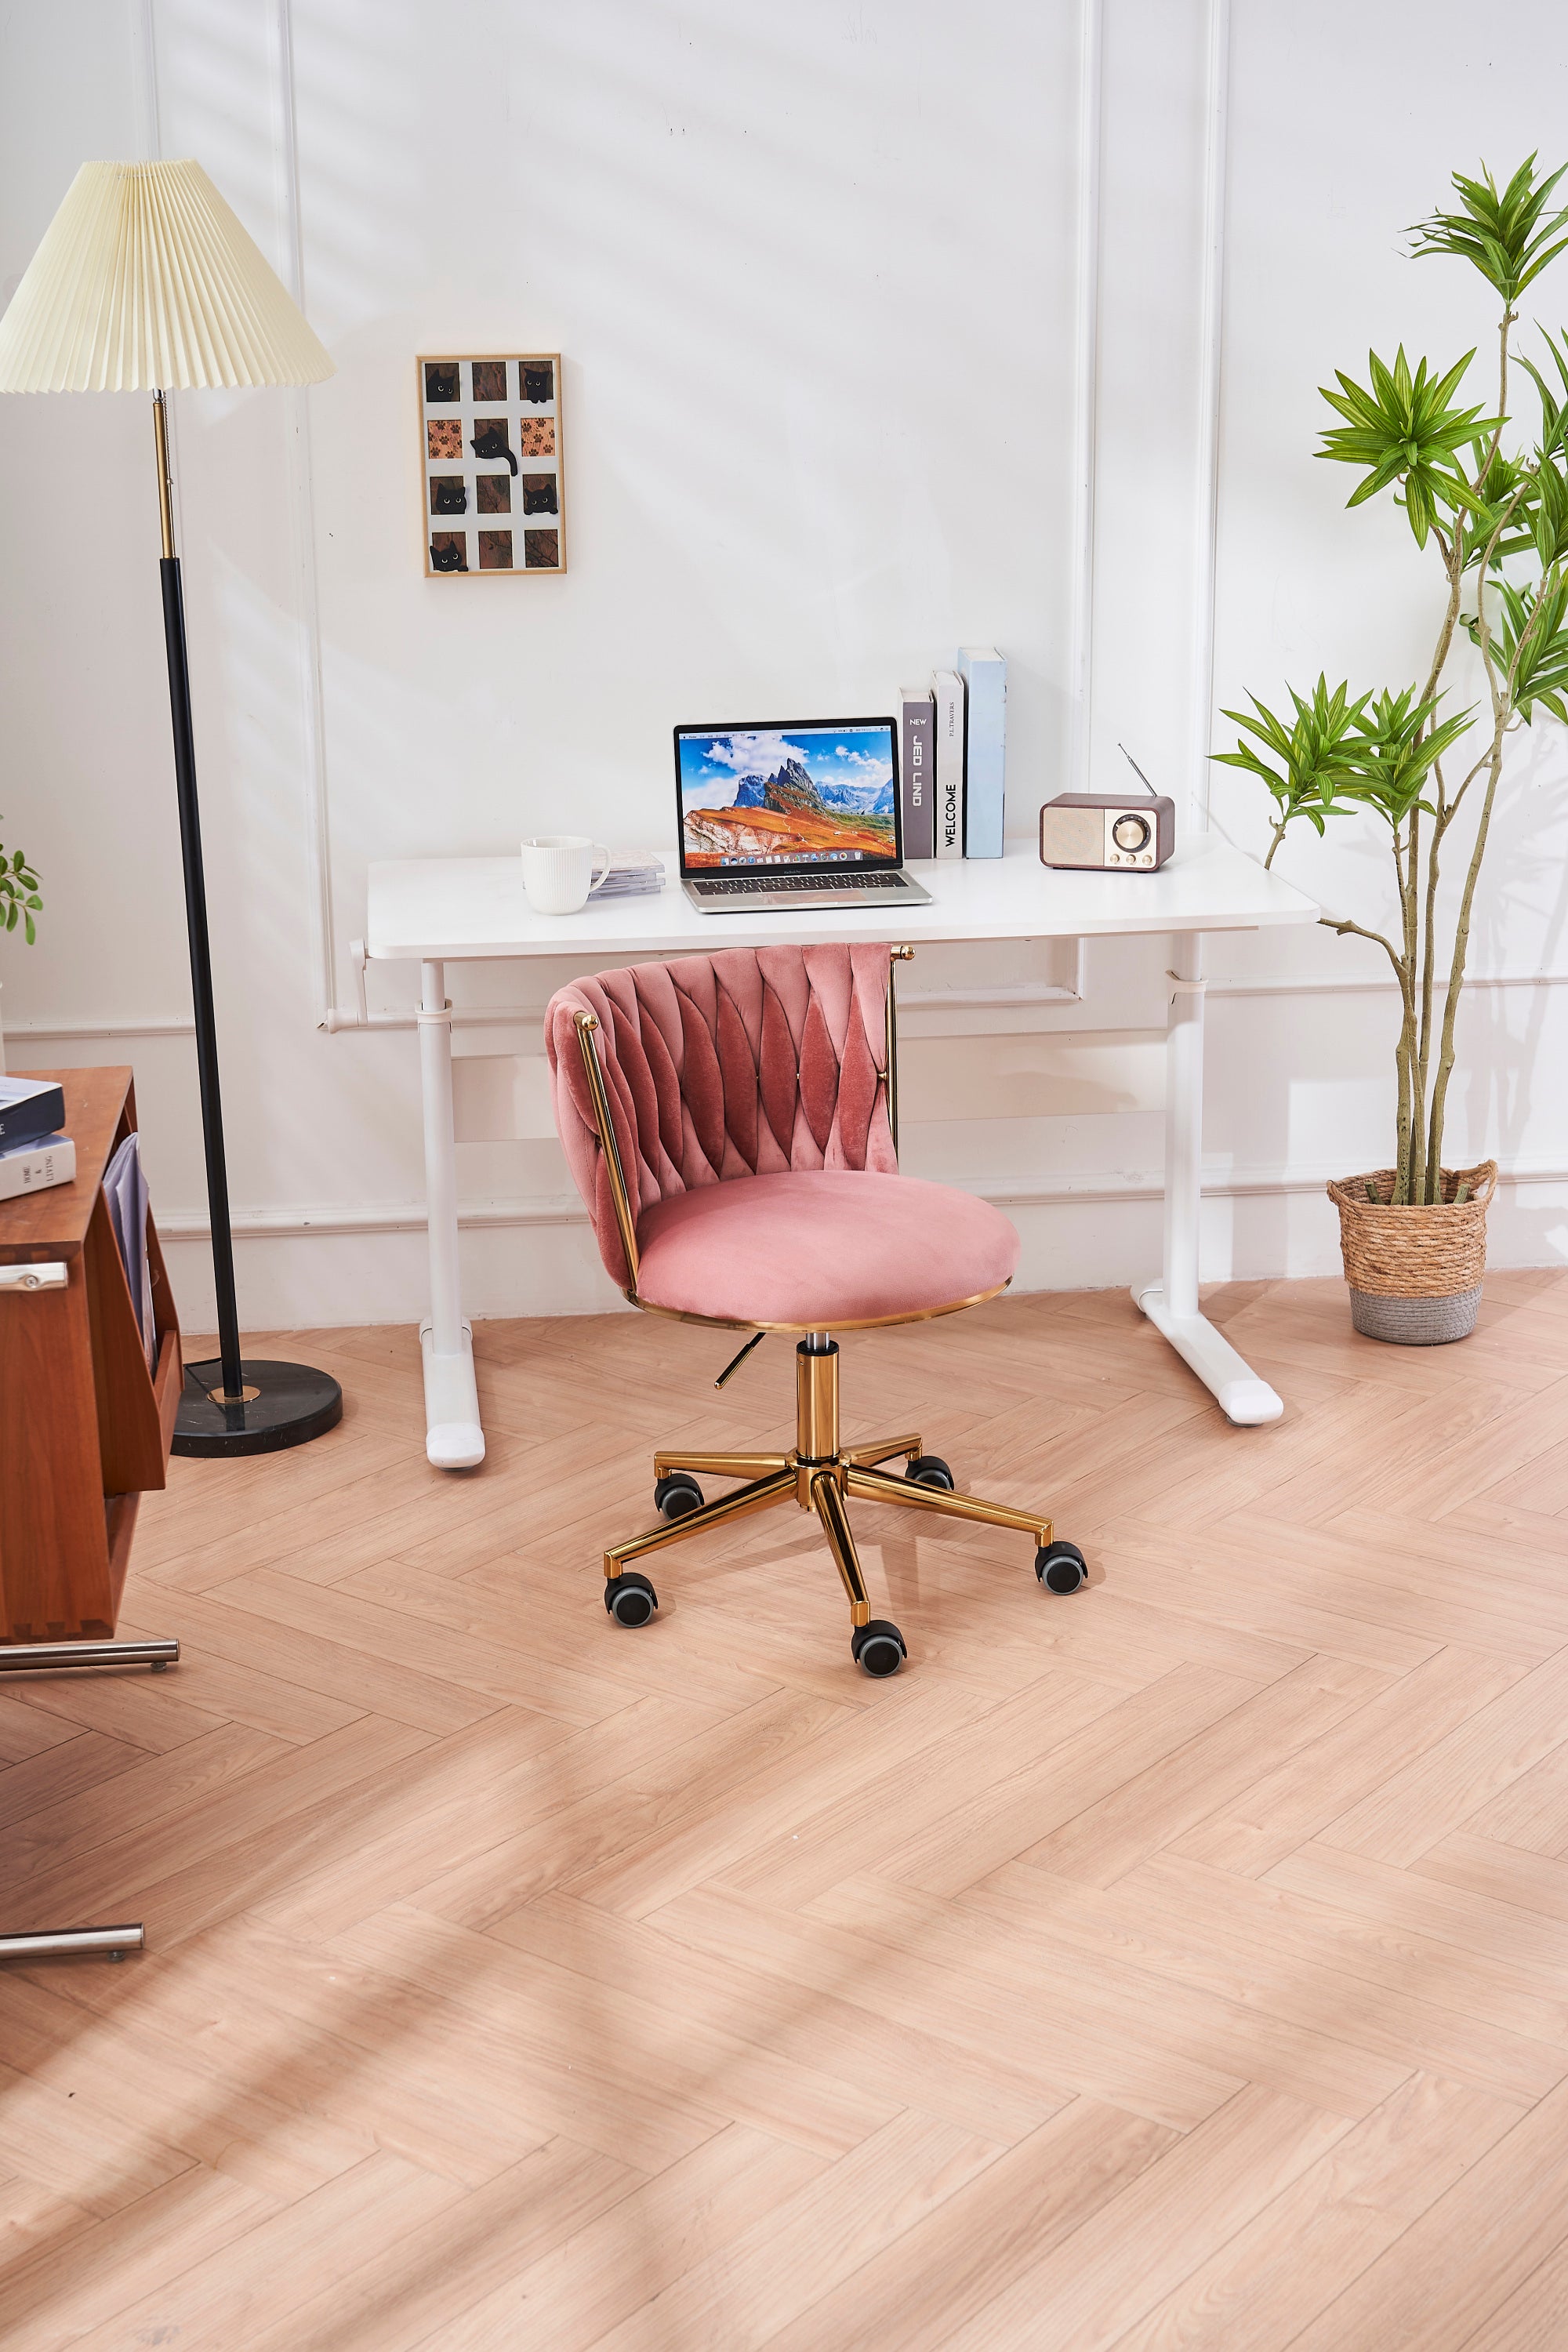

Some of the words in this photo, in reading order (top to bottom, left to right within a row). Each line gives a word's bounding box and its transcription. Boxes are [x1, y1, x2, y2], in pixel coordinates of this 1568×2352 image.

[913, 735, 923, 766] JED
[913, 772, 922, 807] LIND
[946, 784, 956, 848] WELCOME
[23, 1165, 31, 1184] HOME
[45, 1156, 54, 1181] LIVING
